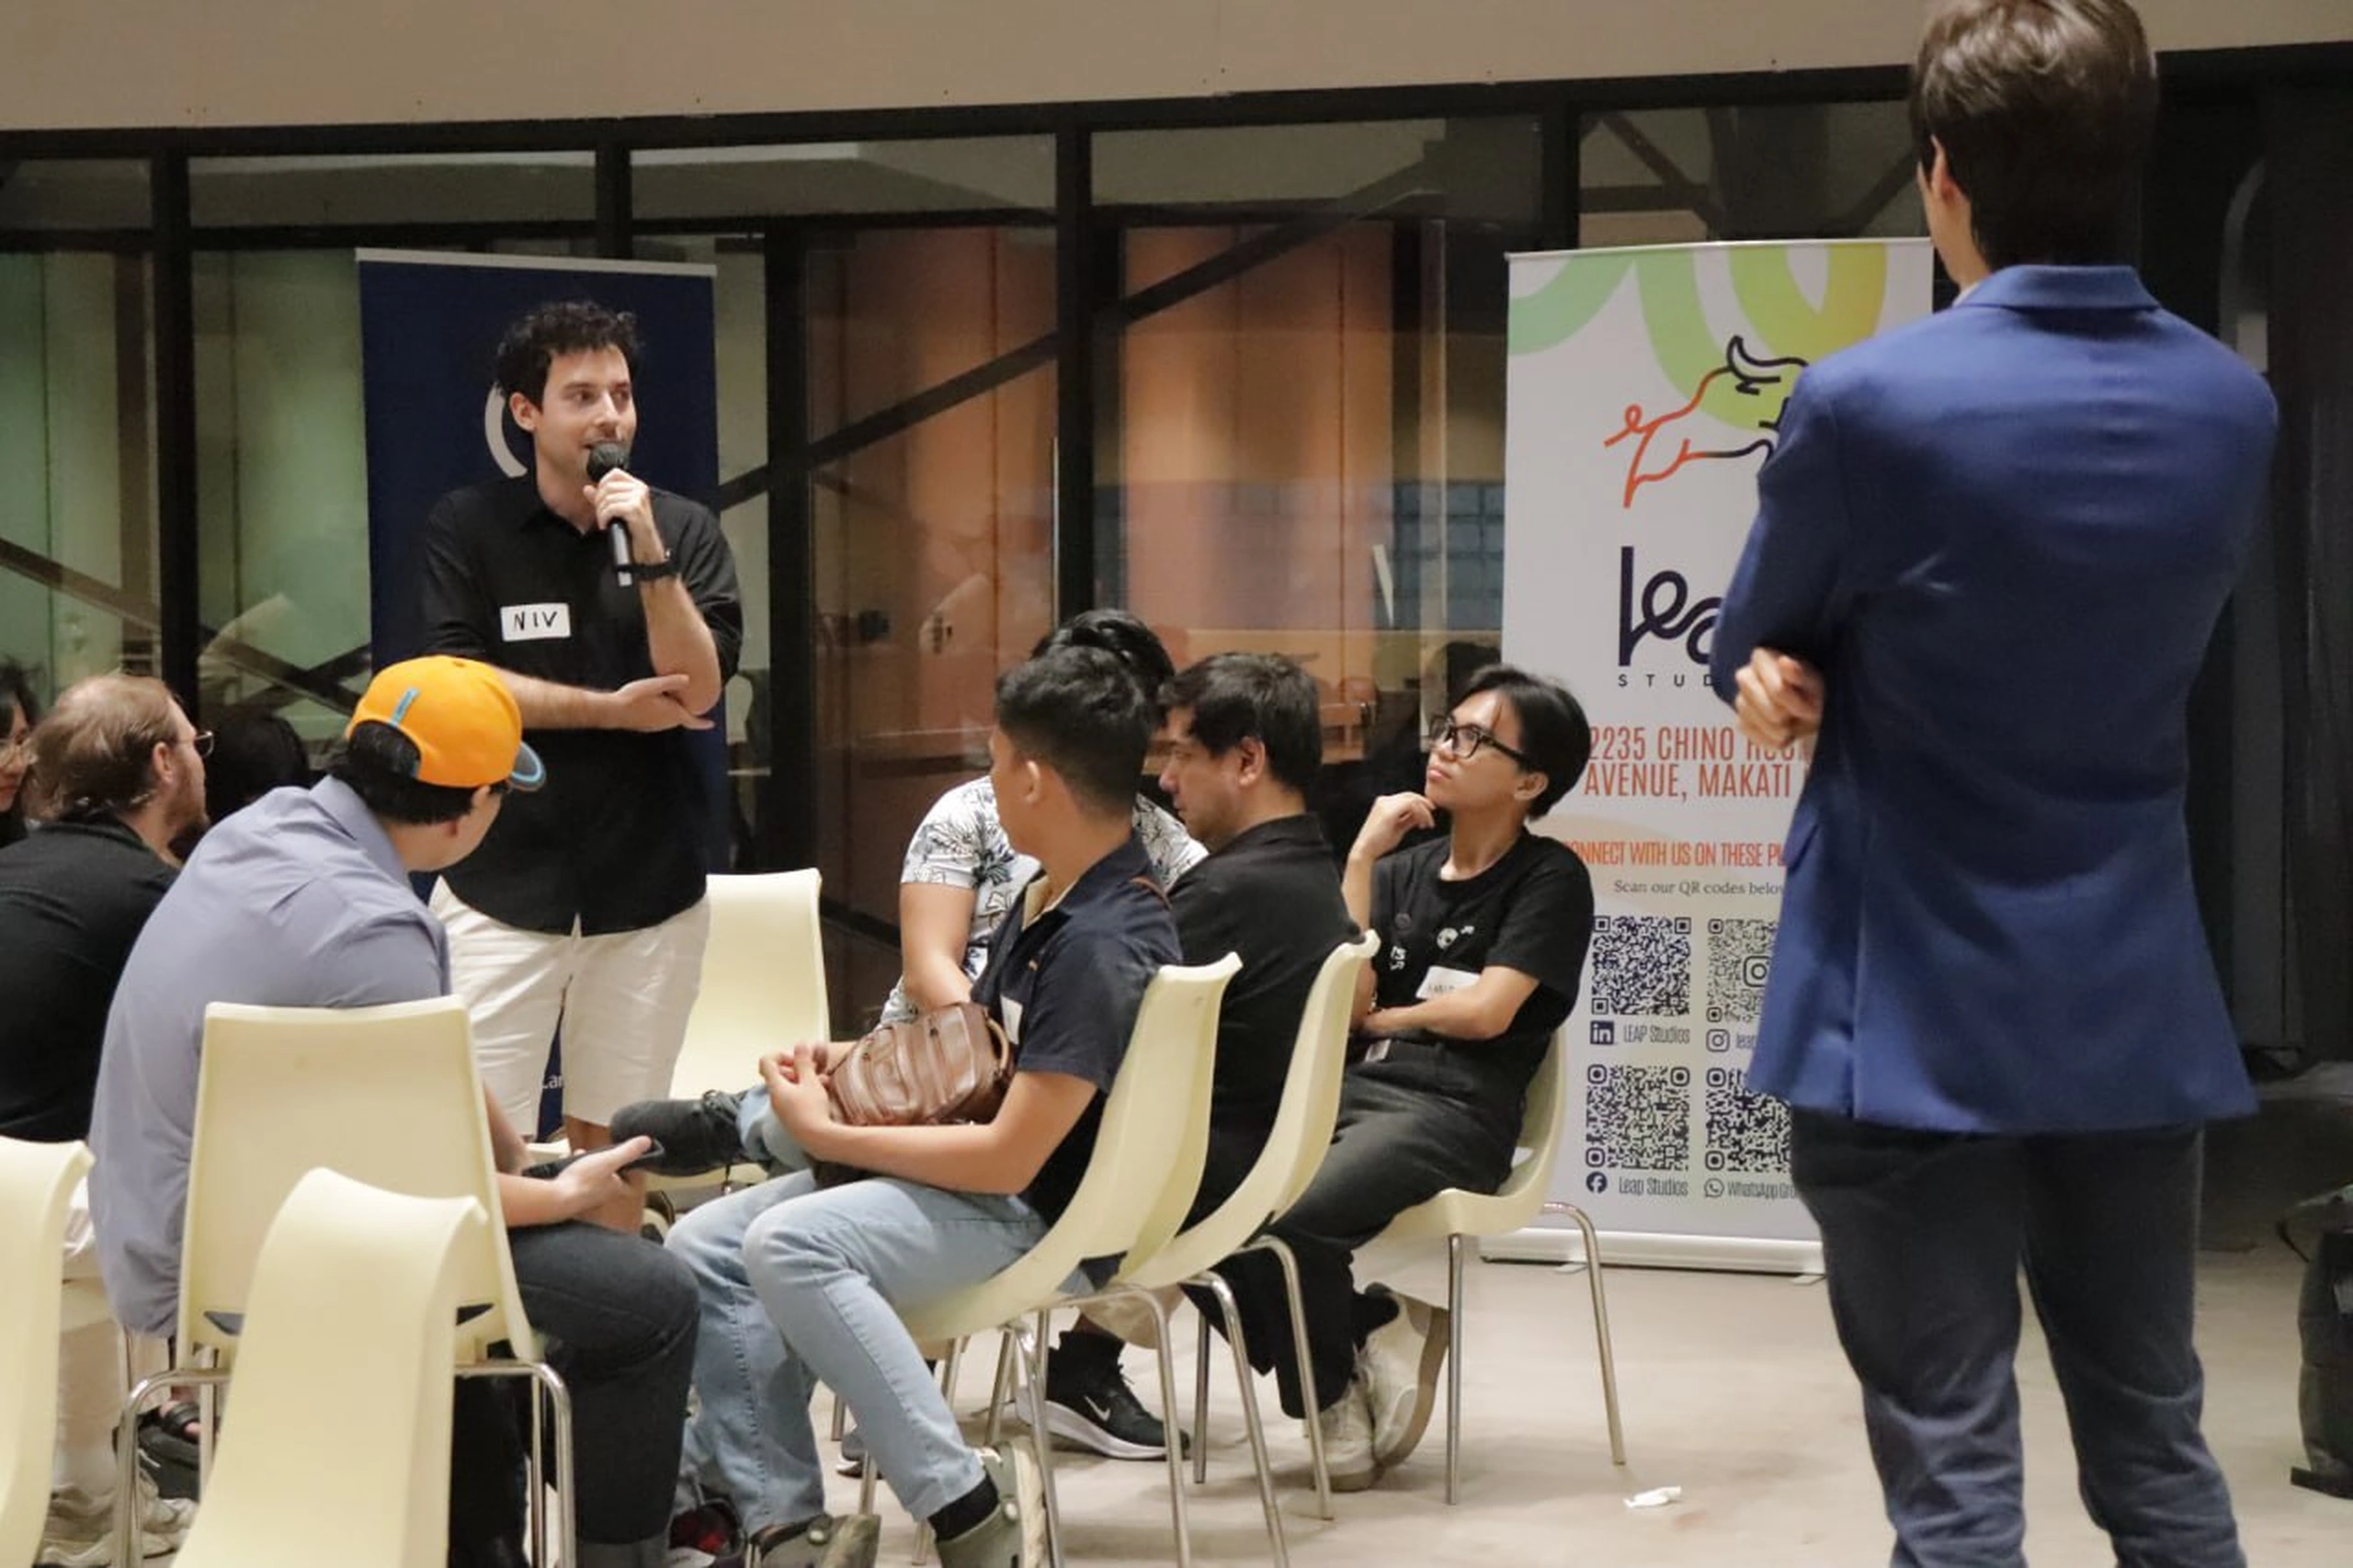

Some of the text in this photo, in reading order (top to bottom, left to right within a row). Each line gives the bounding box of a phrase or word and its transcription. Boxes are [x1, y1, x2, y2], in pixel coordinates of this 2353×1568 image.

[515, 611, 558, 631] NIV
[1618, 674, 1713, 687] STUD
[1588, 726, 1646, 760] 2235
[1657, 726, 1735, 761] CHINO
[1584, 763, 1790, 802] AVENUE, MAKATI
[1567, 840, 1624, 866] ONNECT
[1630, 841, 1666, 866] WITH
[1671, 841, 1690, 867] US
[1695, 841, 1716, 867] ON
[1721, 842, 1763, 867] THESE
[1614, 880, 1647, 893] Scan
[1651, 882, 1676, 893] our
[1678, 881, 1699, 896] QR
[1703, 881, 1745, 894] codes
[1619, 1176, 1688, 1197] Leap Studios
